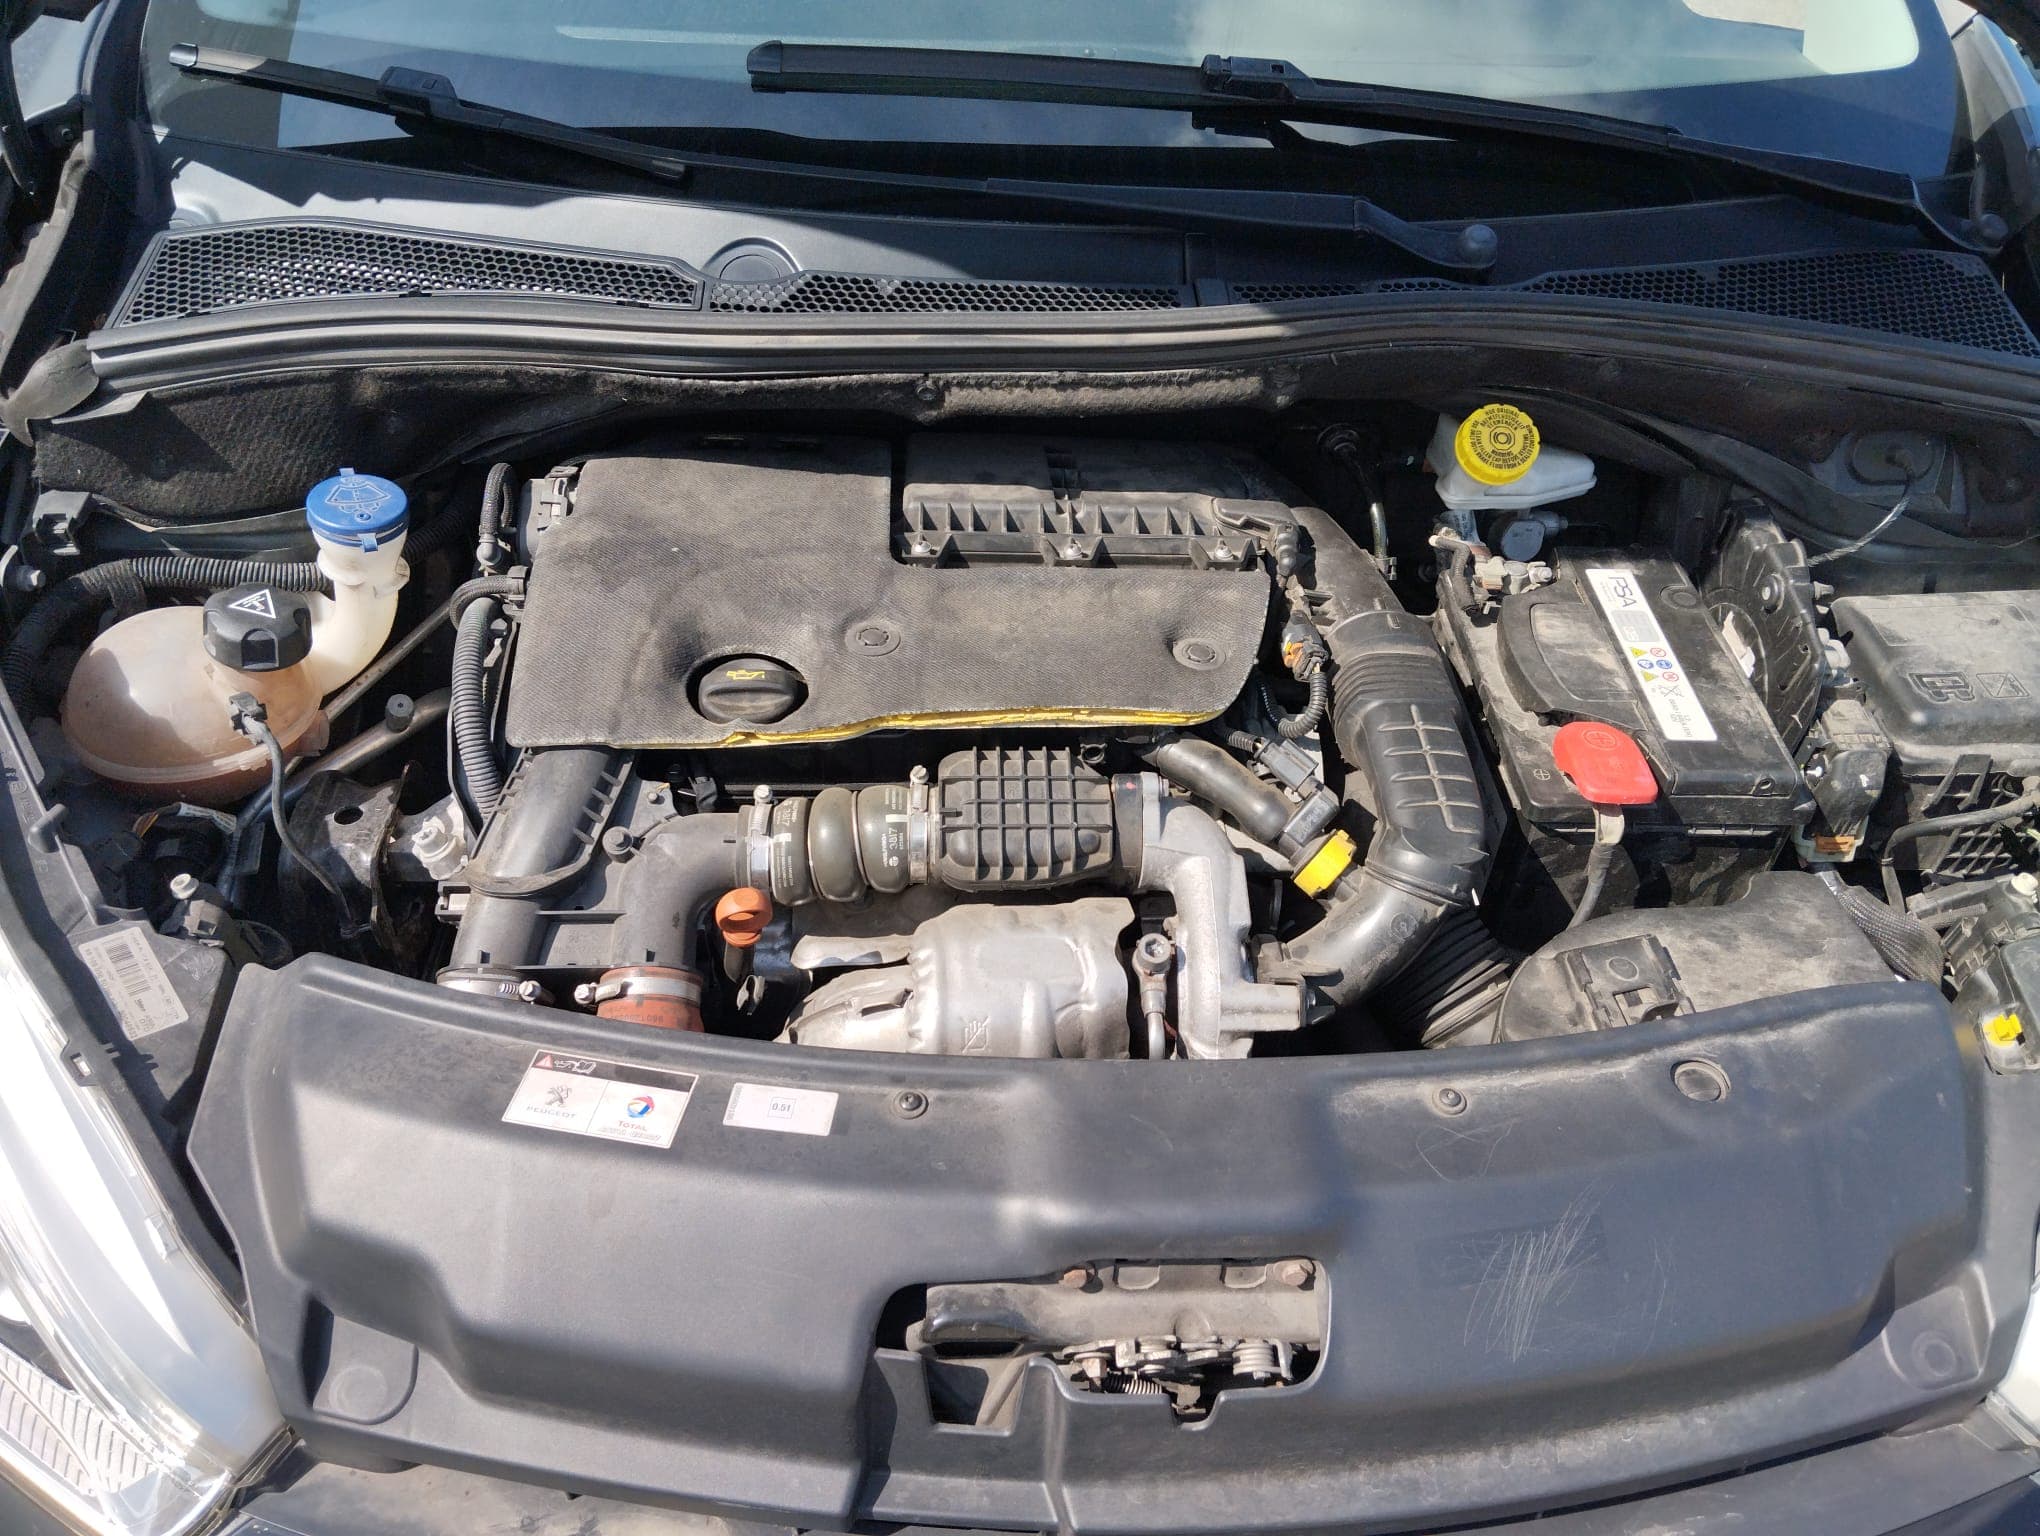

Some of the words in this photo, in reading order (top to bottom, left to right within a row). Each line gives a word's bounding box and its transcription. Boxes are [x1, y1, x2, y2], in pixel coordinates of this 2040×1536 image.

[1496, 407, 1520, 417] ORIGINAL
[1479, 446, 1492, 460] FILLER
[1502, 454, 1519, 464] BEFORE
[1518, 433, 1529, 457] REMOVING
[1491, 449, 1512, 457] WARNING
[1477, 451, 1490, 465] BRAKE
[1607, 576, 1637, 607] PSA
[888, 828, 898, 850] 3817
[526, 1104, 576, 1119] PEUGEOT
[618, 1120, 648, 1132] TOTAL
